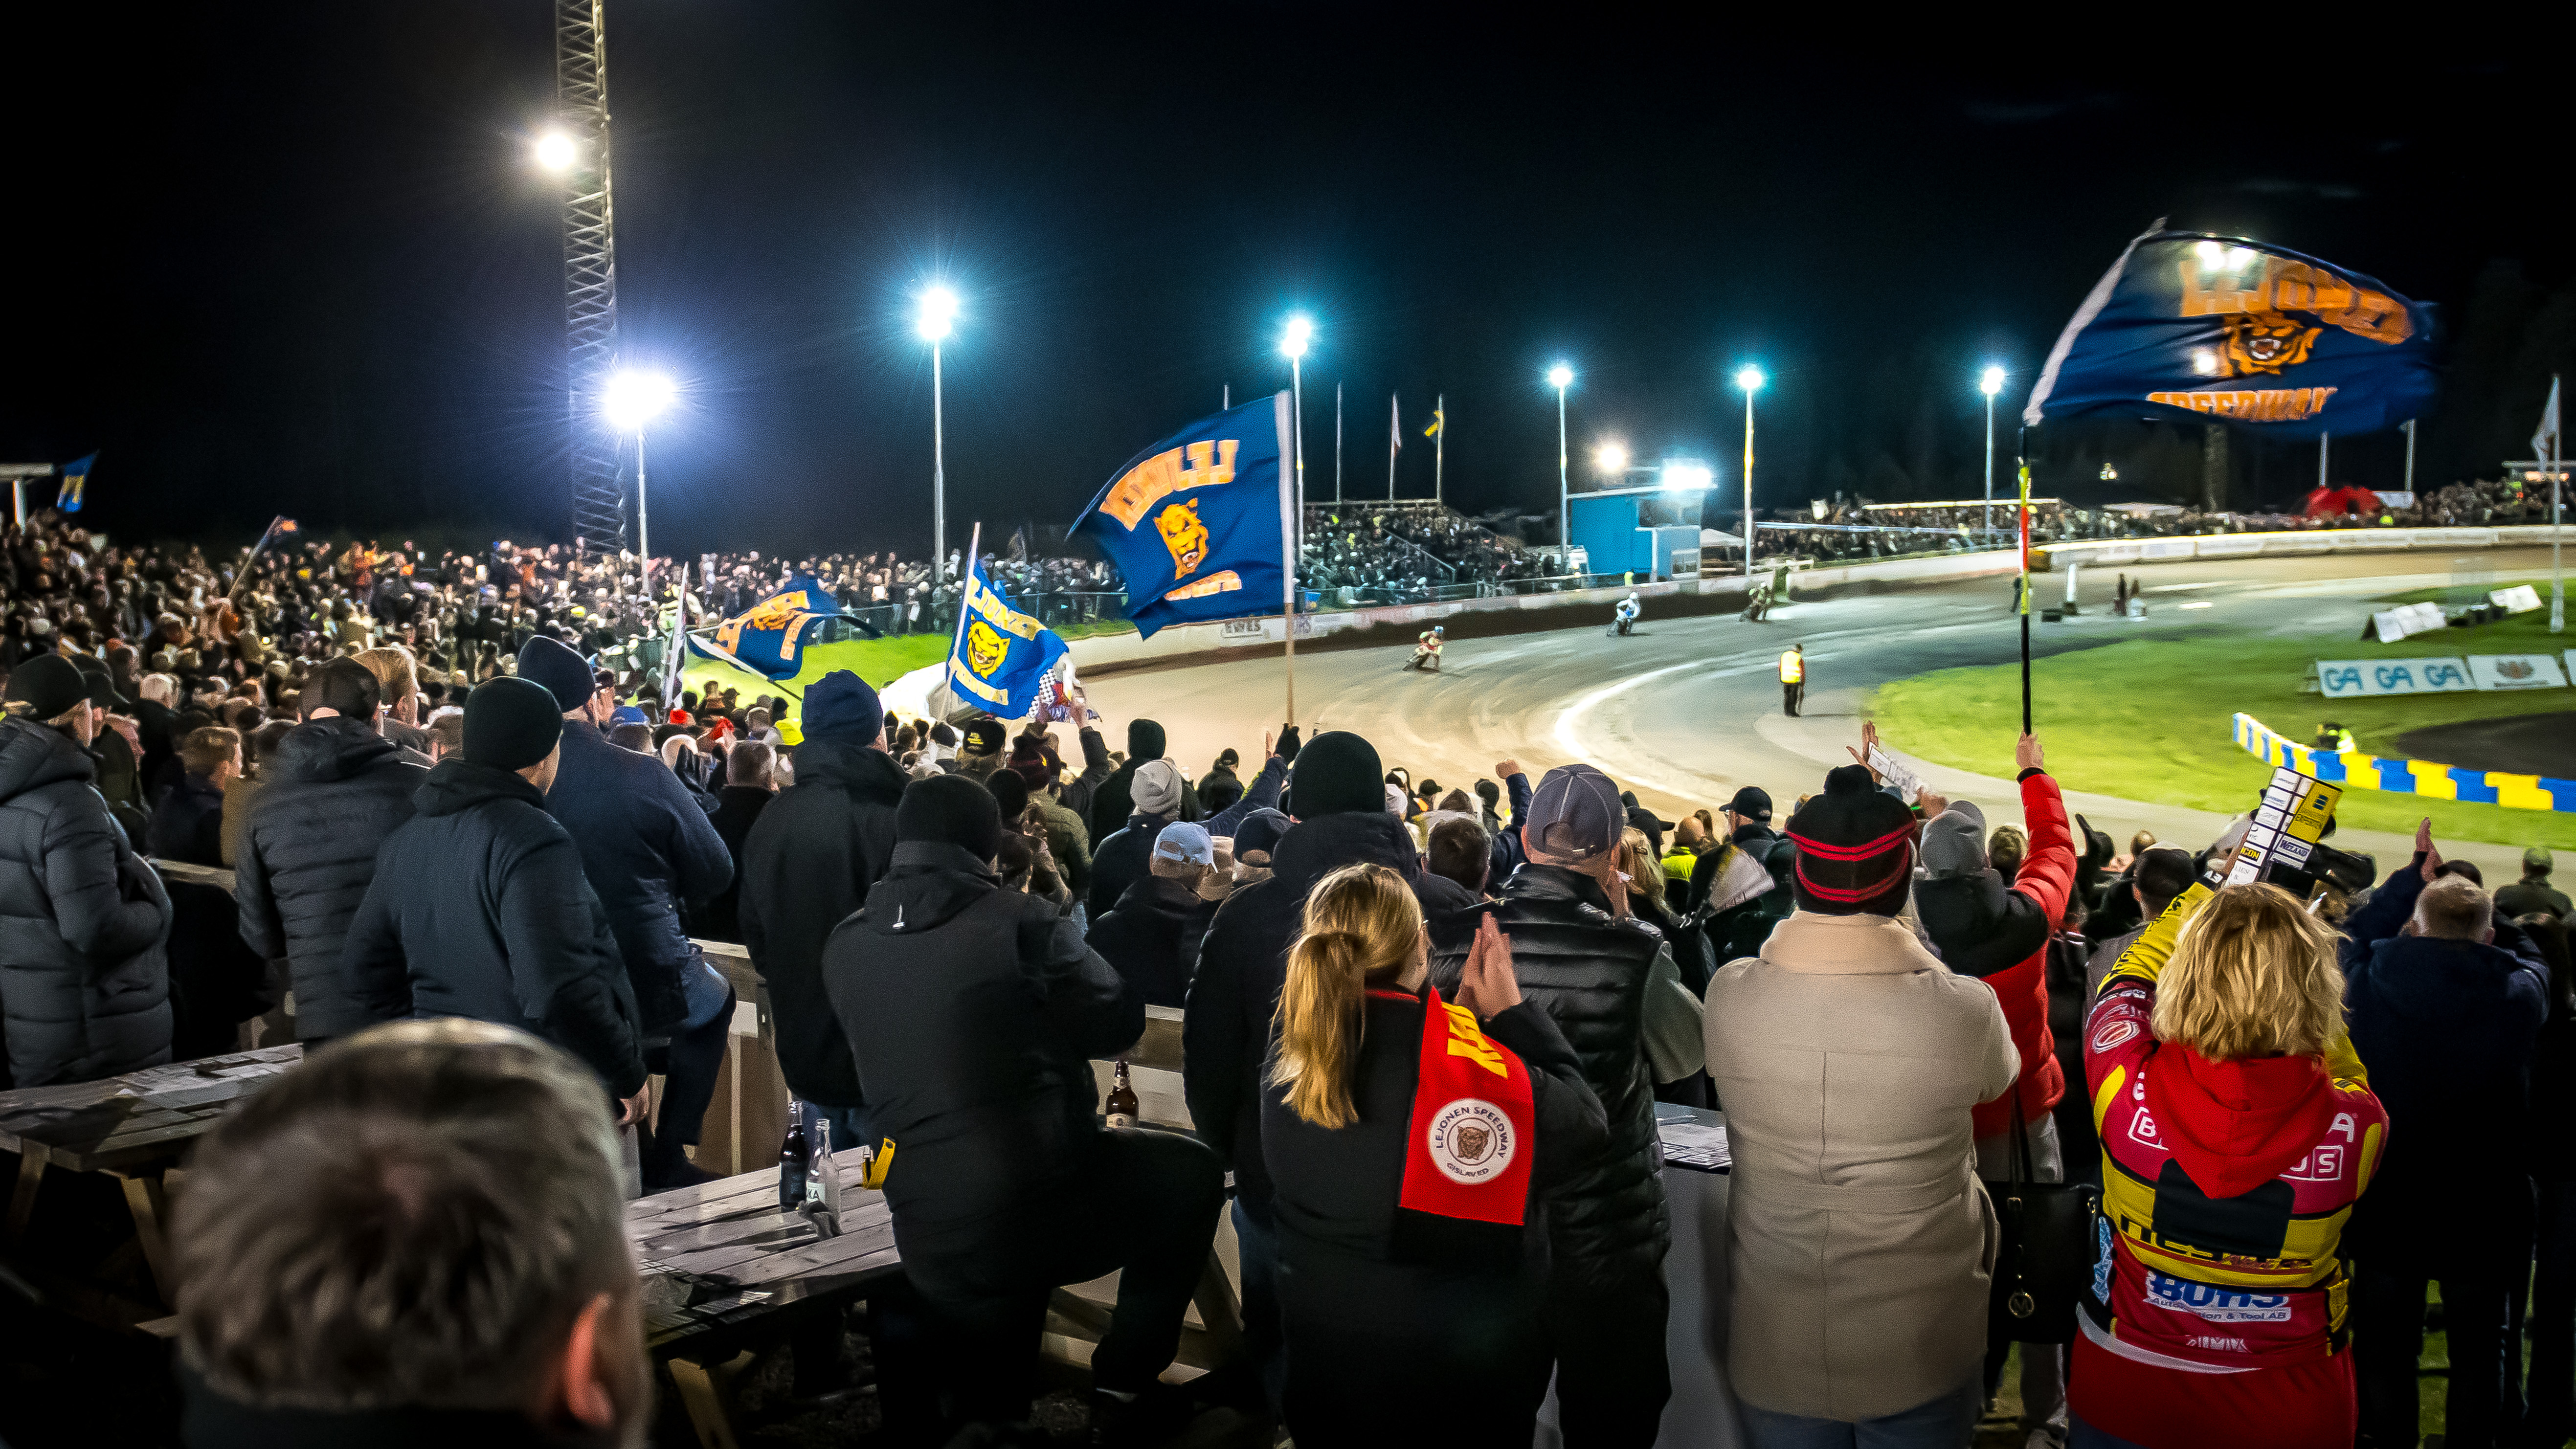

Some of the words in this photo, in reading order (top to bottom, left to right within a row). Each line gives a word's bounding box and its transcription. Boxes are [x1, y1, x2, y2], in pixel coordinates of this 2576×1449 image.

[1435, 1107, 1470, 1148] LEJONEN
[1474, 1107, 1508, 1159] SPEEDWAY
[1447, 1162, 1489, 1177] GISLAVED
